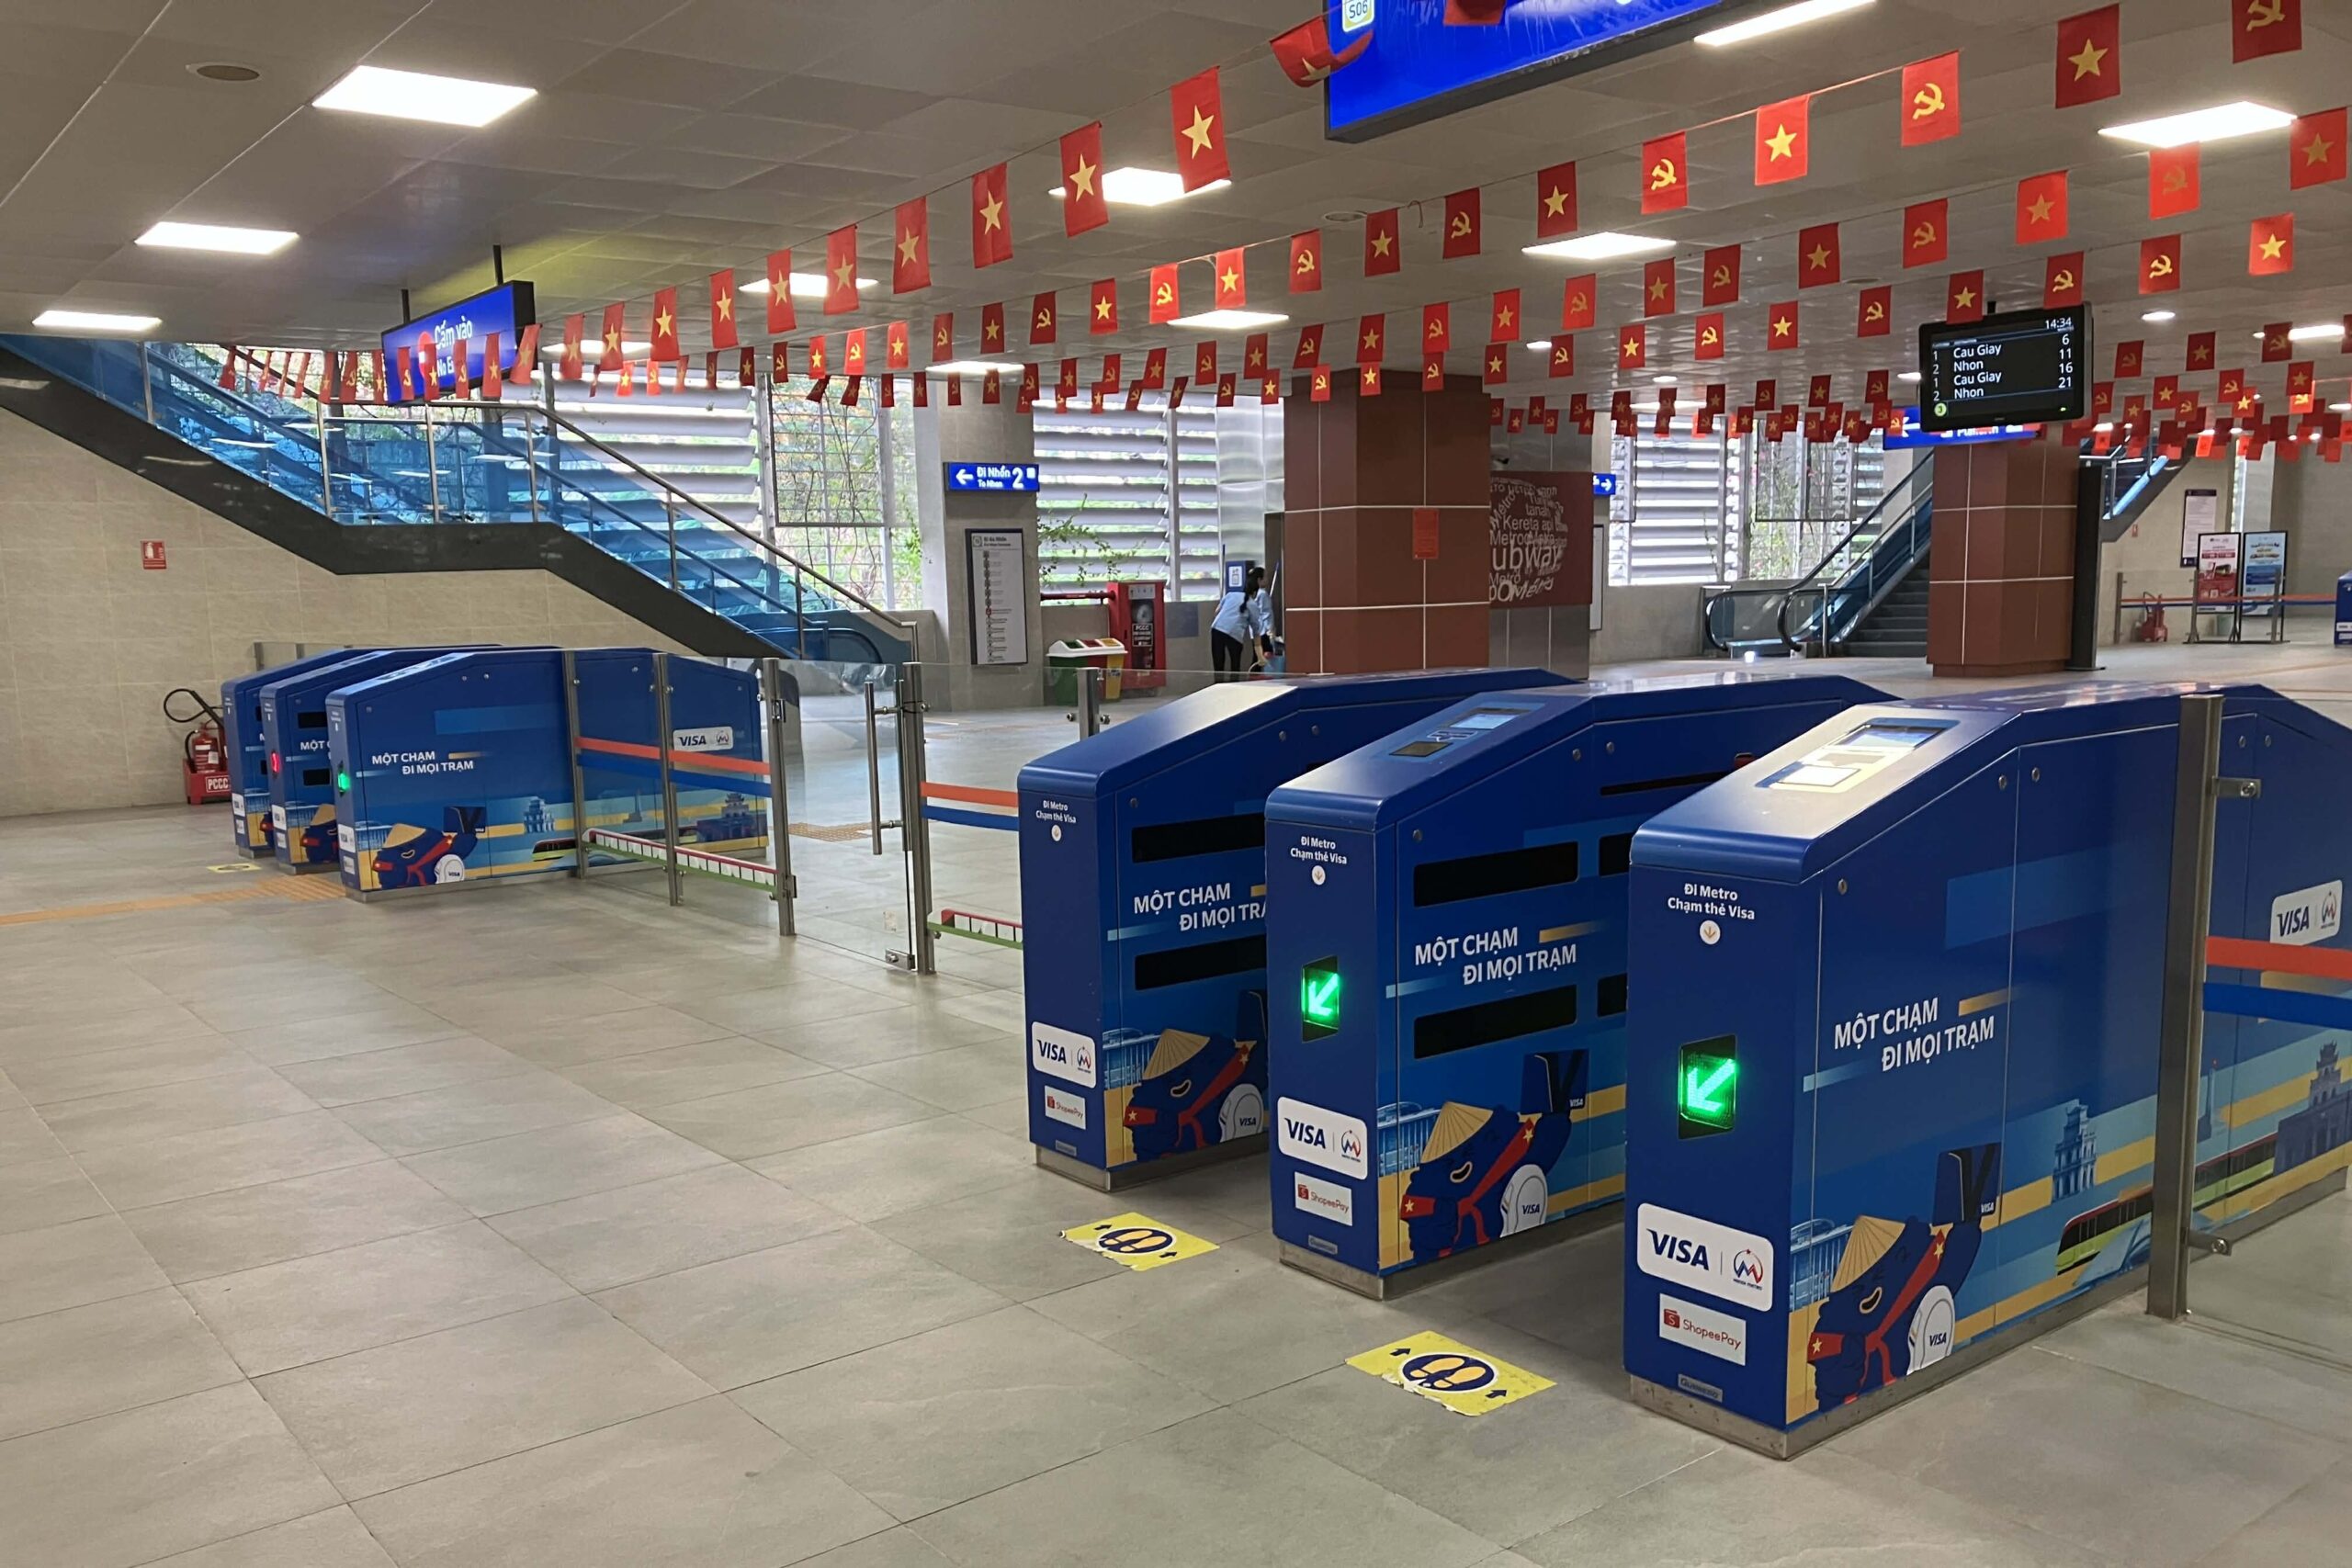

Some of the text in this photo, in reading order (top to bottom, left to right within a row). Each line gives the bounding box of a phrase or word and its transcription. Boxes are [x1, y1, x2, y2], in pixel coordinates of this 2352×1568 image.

[1349, 0, 1368, 18] S06
[435, 315, 472, 350] Cấm vào
[2045, 317, 2072, 329] 14:34
[1933, 333, 2070, 361] 1 Cau Giay 6
[1933, 348, 2072, 375] 2 Nhon 11
[1933, 362, 2073, 389] 1 Cau Giay 16
[1933, 377, 2072, 401] 2 Nhon 21
[978, 479, 986, 488] To
[1012, 467, 1023, 489] 2
[1503, 514, 1539, 531] Kereta
[1492, 538, 1561, 570] ubway
[300, 739, 325, 751] MỘT
[678, 735, 707, 747] VISA
[372, 750, 435, 766] MỘT CHẠM
[401, 761, 474, 775] ĐI MỌI TRẠM
[208, 777, 229, 791] PCCC
[1035, 810, 1053, 821] Chạm
[1064, 814, 1077, 824] Visa
[1050, 801, 1069, 811] Metro
[1311, 837, 1336, 850] Metro
[1290, 848, 1314, 861] Chạm
[1329, 852, 1347, 864] Visa
[1134, 883, 1231, 915] MỘT CHẠM
[1700, 885, 1738, 901] Metro
[1179, 914, 1198, 931] ĐI
[1202, 907, 1235, 929] MỌI
[1668, 897, 1755, 919] Chạm thẻ Visa
[2277, 906, 2309, 937] VISA
[1415, 926, 1518, 966] MỘT CHẠM
[1463, 943, 1577, 986] ĐI MỌI TRẠM
[1835, 997, 1939, 1050] MỘT CHẠM
[1036, 1039, 1067, 1065] VISA
[1882, 1015, 1995, 1072] ĐI MỌI TRẠM
[1569, 1098, 1584, 1108] VISA
[1239, 1117, 1257, 1127] VISA
[1284, 1117, 1327, 1150] VISA
[1310, 1191, 1349, 1213] ShopeePay
[1521, 1203, 1541, 1215] VISA
[1981, 1202, 1995, 1213] VISA
[1646, 1228, 1710, 1271] VISA
[1682, 1319, 1742, 1350] ShopeePay
[1929, 1332, 1947, 1347] VISA
